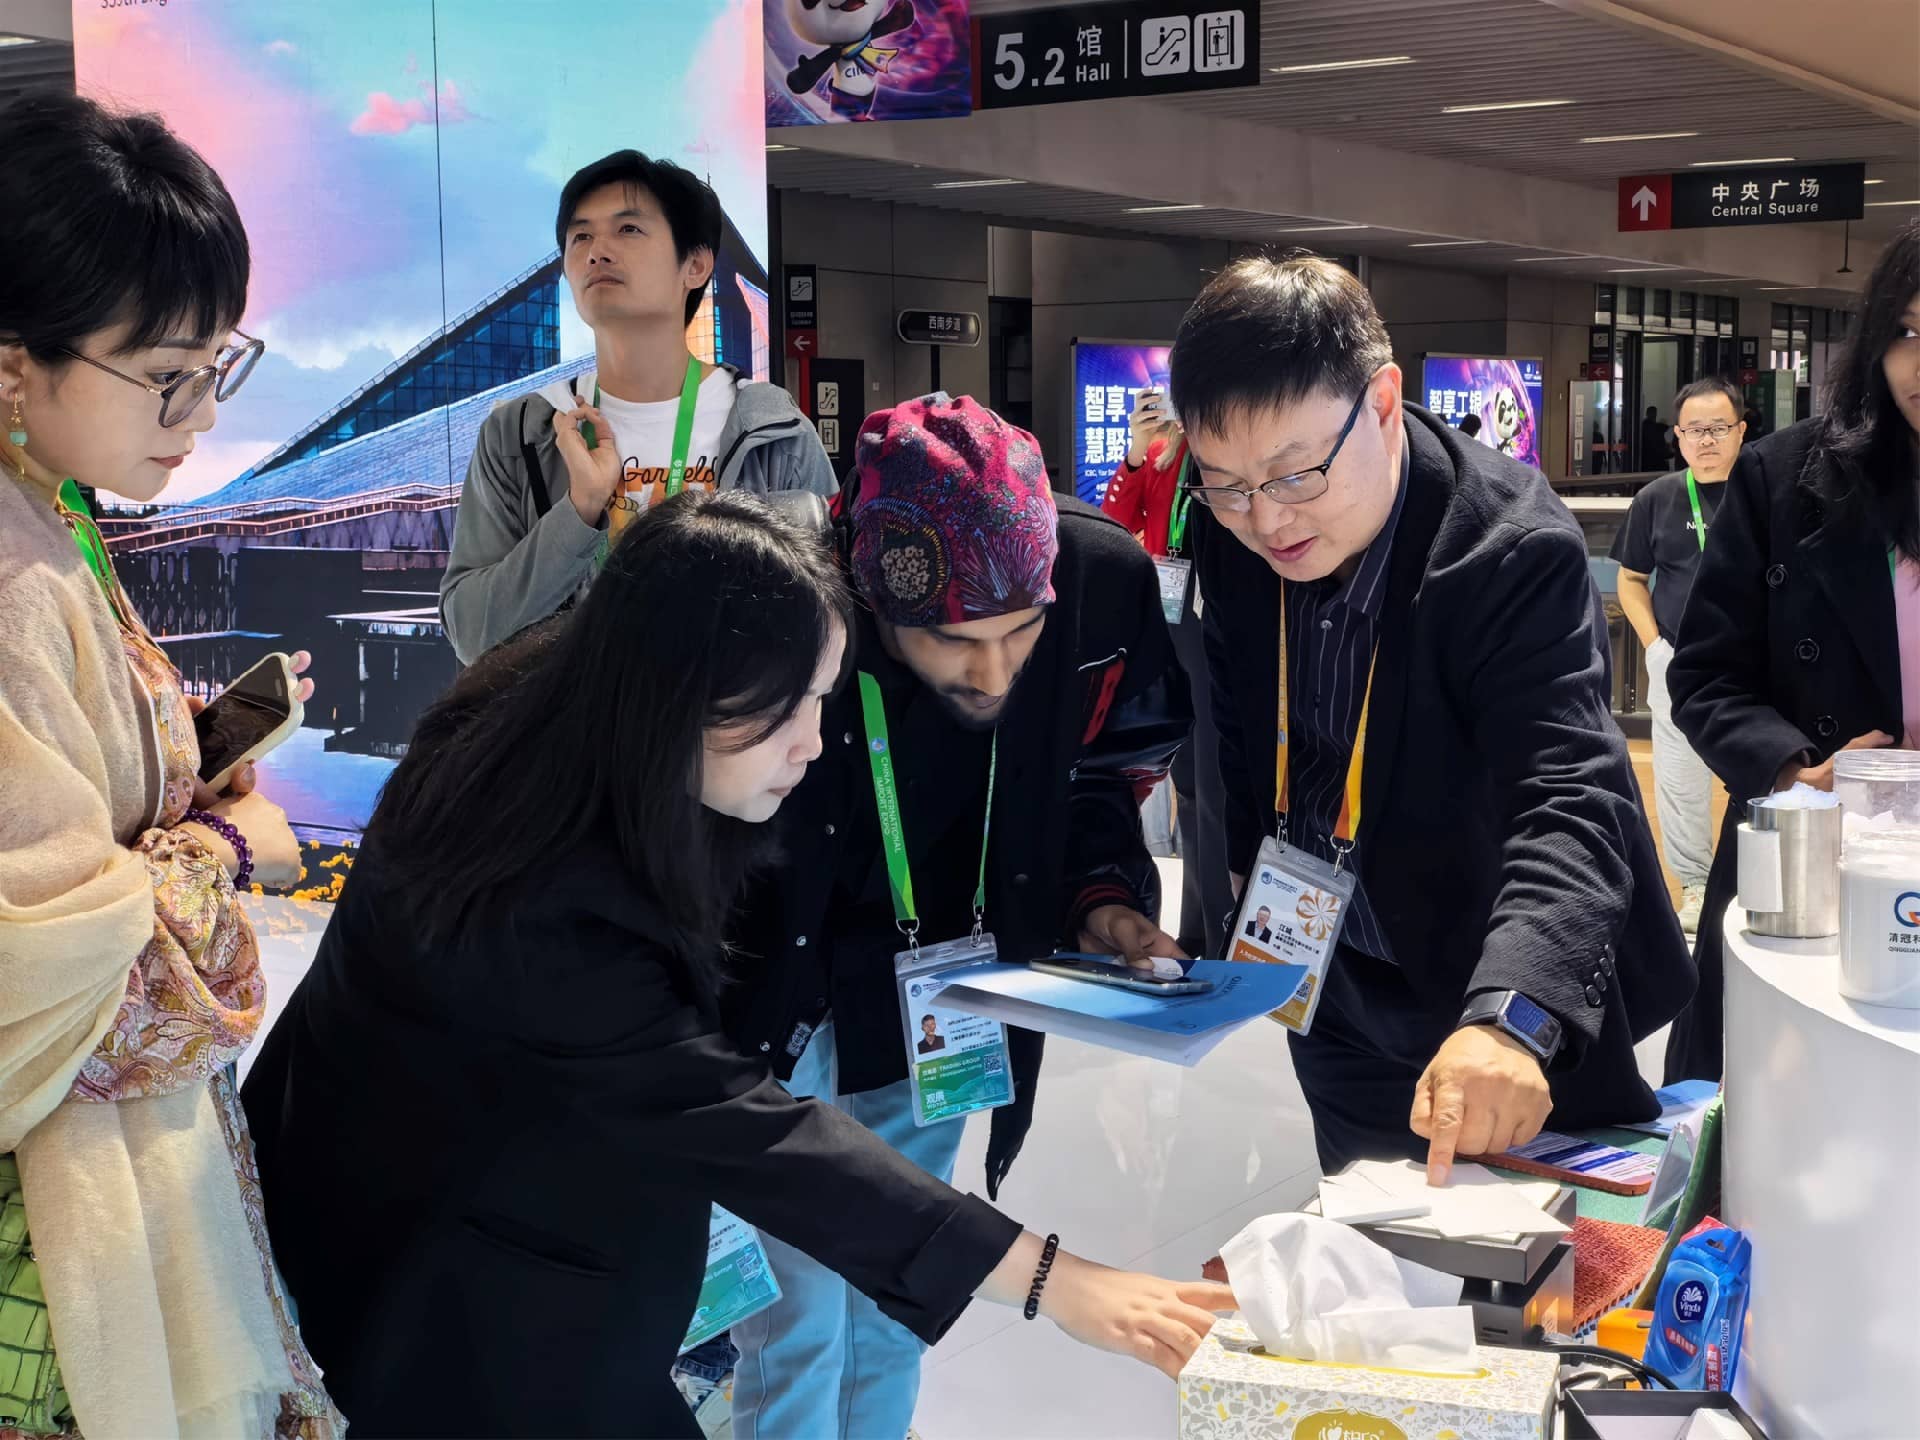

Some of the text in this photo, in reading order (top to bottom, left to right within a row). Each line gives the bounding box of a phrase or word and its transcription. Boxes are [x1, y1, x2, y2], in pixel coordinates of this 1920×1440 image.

[1076, 25, 1103, 56] 馆
[994, 32, 1065, 91] 5.2
[1076, 63, 1110, 83] Hall
[1711, 178, 1820, 203] 中央广场
[1711, 202, 1819, 217] Central Square
[1085, 427, 1132, 464] 慧聚
[622, 456, 718, 490] Gareld
[877, 777, 887, 809] IMPORT
[881, 757, 901, 853] CHINA INTERNATIONAL
[1680, 1301, 1701, 1313] Vinda
